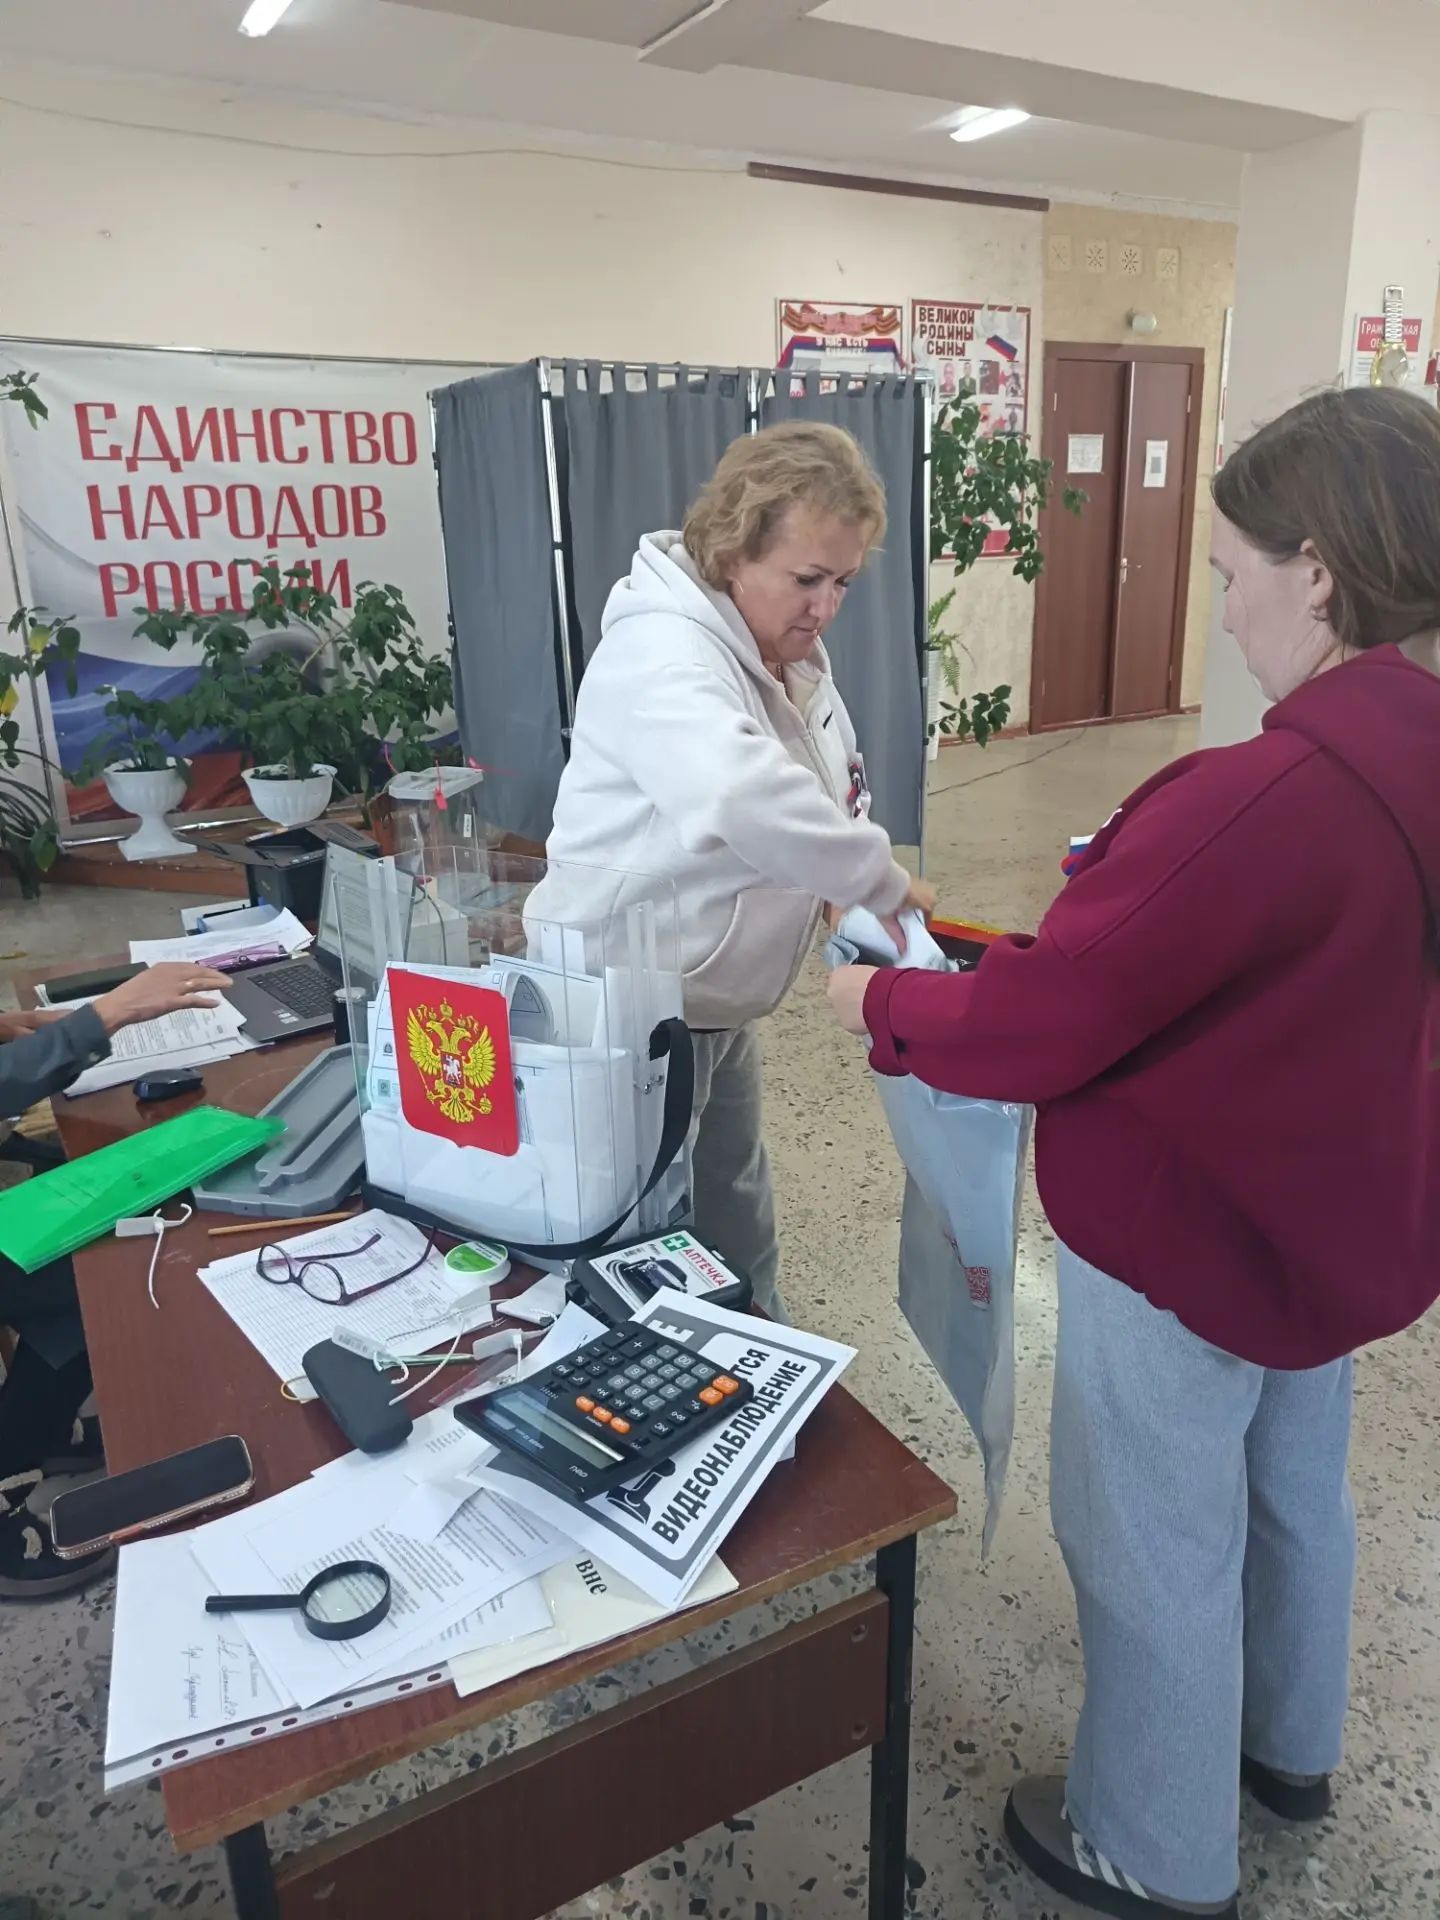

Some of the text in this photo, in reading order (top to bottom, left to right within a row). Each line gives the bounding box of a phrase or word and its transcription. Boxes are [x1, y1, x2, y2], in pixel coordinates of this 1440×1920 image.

[919, 306, 975, 325] ВЕЛИКОЙ
[919, 323, 974, 341] РОДИНЫ
[926, 341, 966, 357] СЫНЫ
[74, 402, 418, 473] ЕДИНСТВО
[86, 483, 387, 549] НАРОДОВ
[682, 1247, 729, 1288] АПТЕЧКА
[651, 1359, 807, 1545] ВИДЕОНАБЛЮДЕНИЕ
